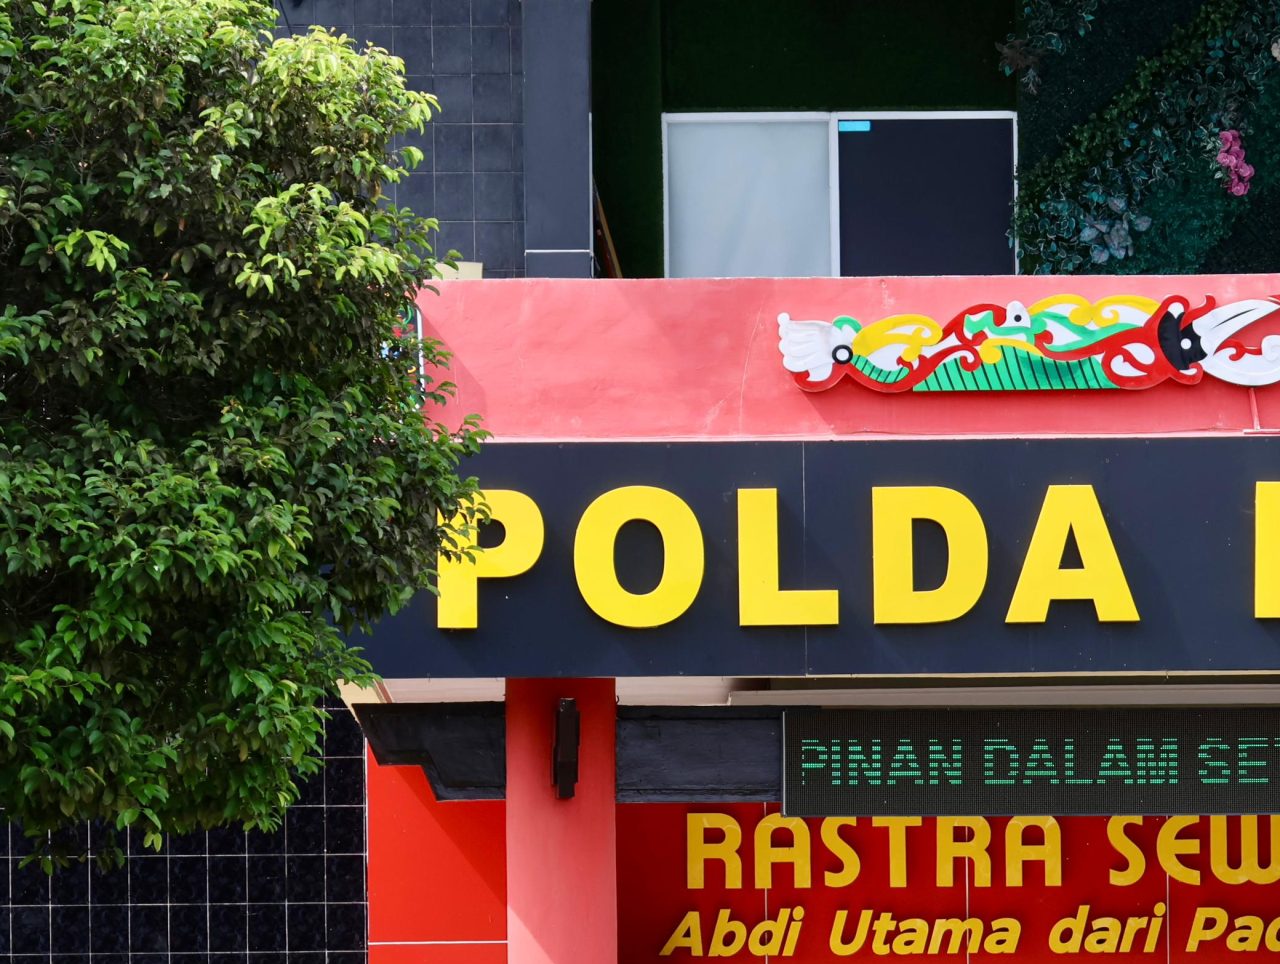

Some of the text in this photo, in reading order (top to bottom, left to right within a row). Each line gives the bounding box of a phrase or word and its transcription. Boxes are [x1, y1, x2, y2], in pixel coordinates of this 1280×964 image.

[436, 484, 1140, 629] POLDA
[801, 739, 962, 785] PINAN
[984, 738, 1178, 785] DALAM
[686, 812, 1062, 890] RASTRA
[660, 905, 805, 957] Abdi
[829, 909, 1022, 957] Utama
[1049, 903, 1167, 954] dari
